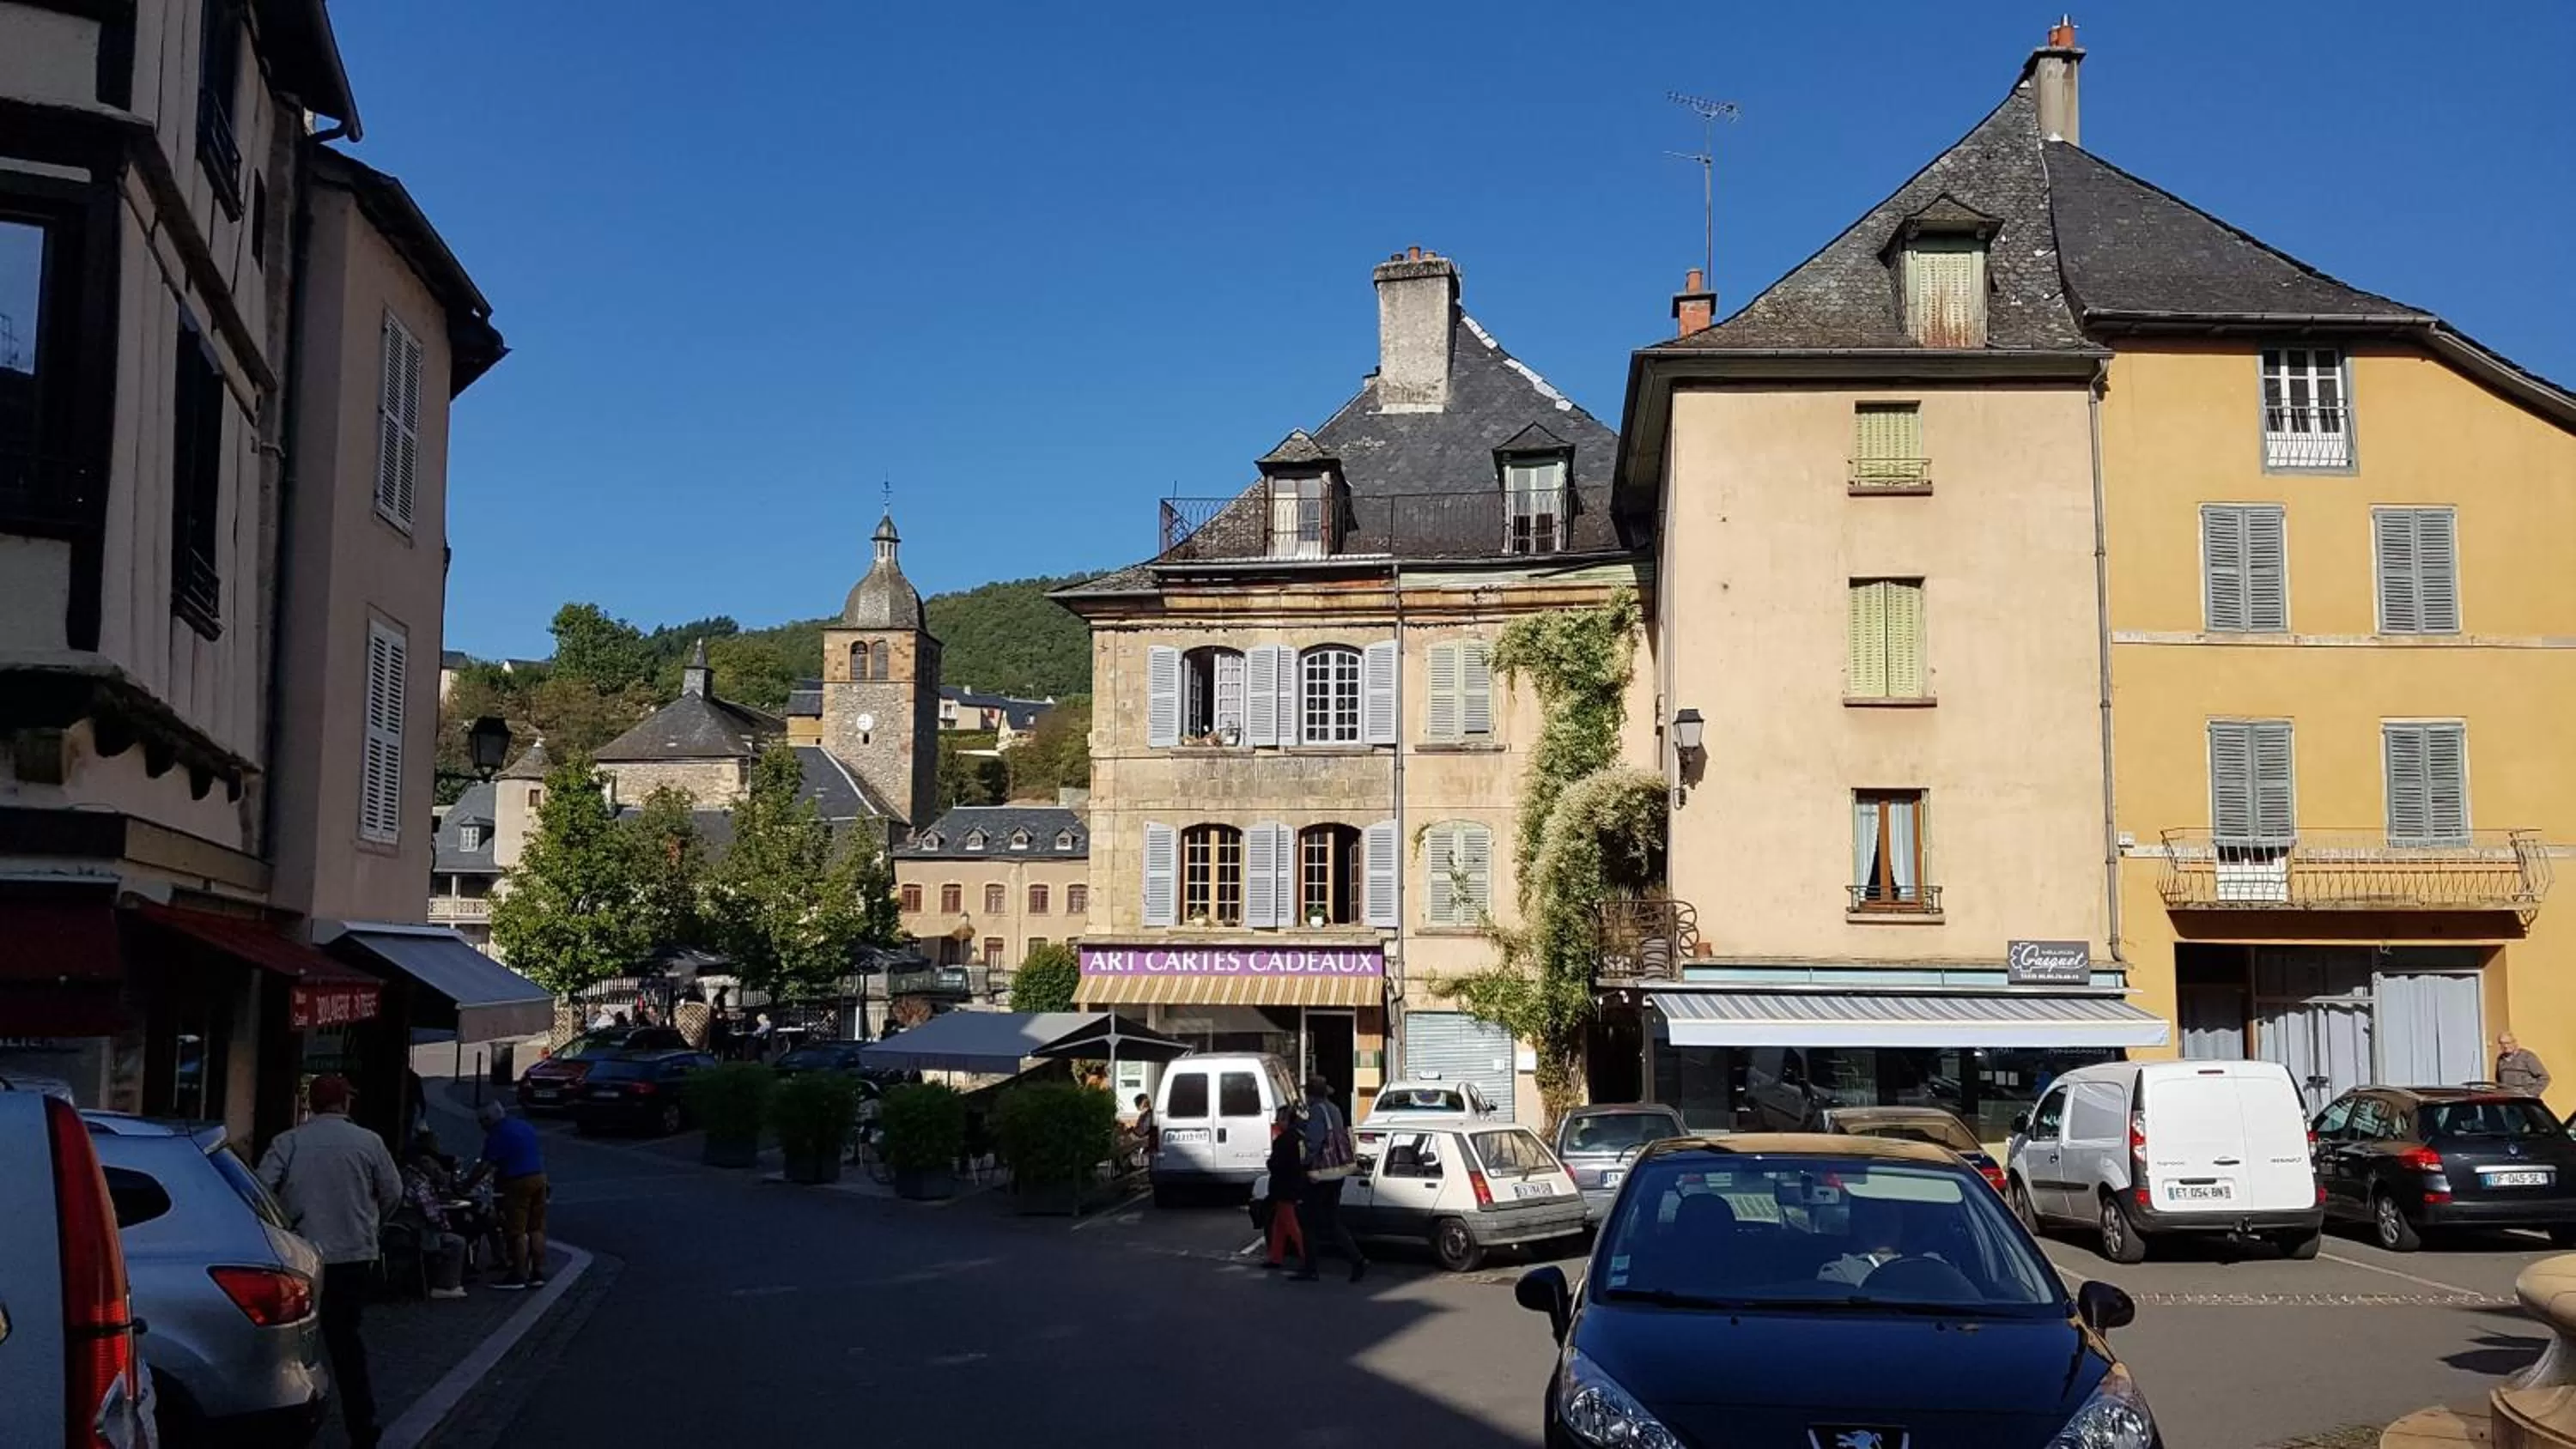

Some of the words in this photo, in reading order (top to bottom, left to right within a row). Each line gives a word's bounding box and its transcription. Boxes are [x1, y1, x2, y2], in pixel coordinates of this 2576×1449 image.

[1087, 951, 1135, 972] ART
[1145, 951, 1241, 973] CARTES
[1248, 952, 1375, 973] CADEAUX
[2020, 945, 2084, 972] Gasquet
